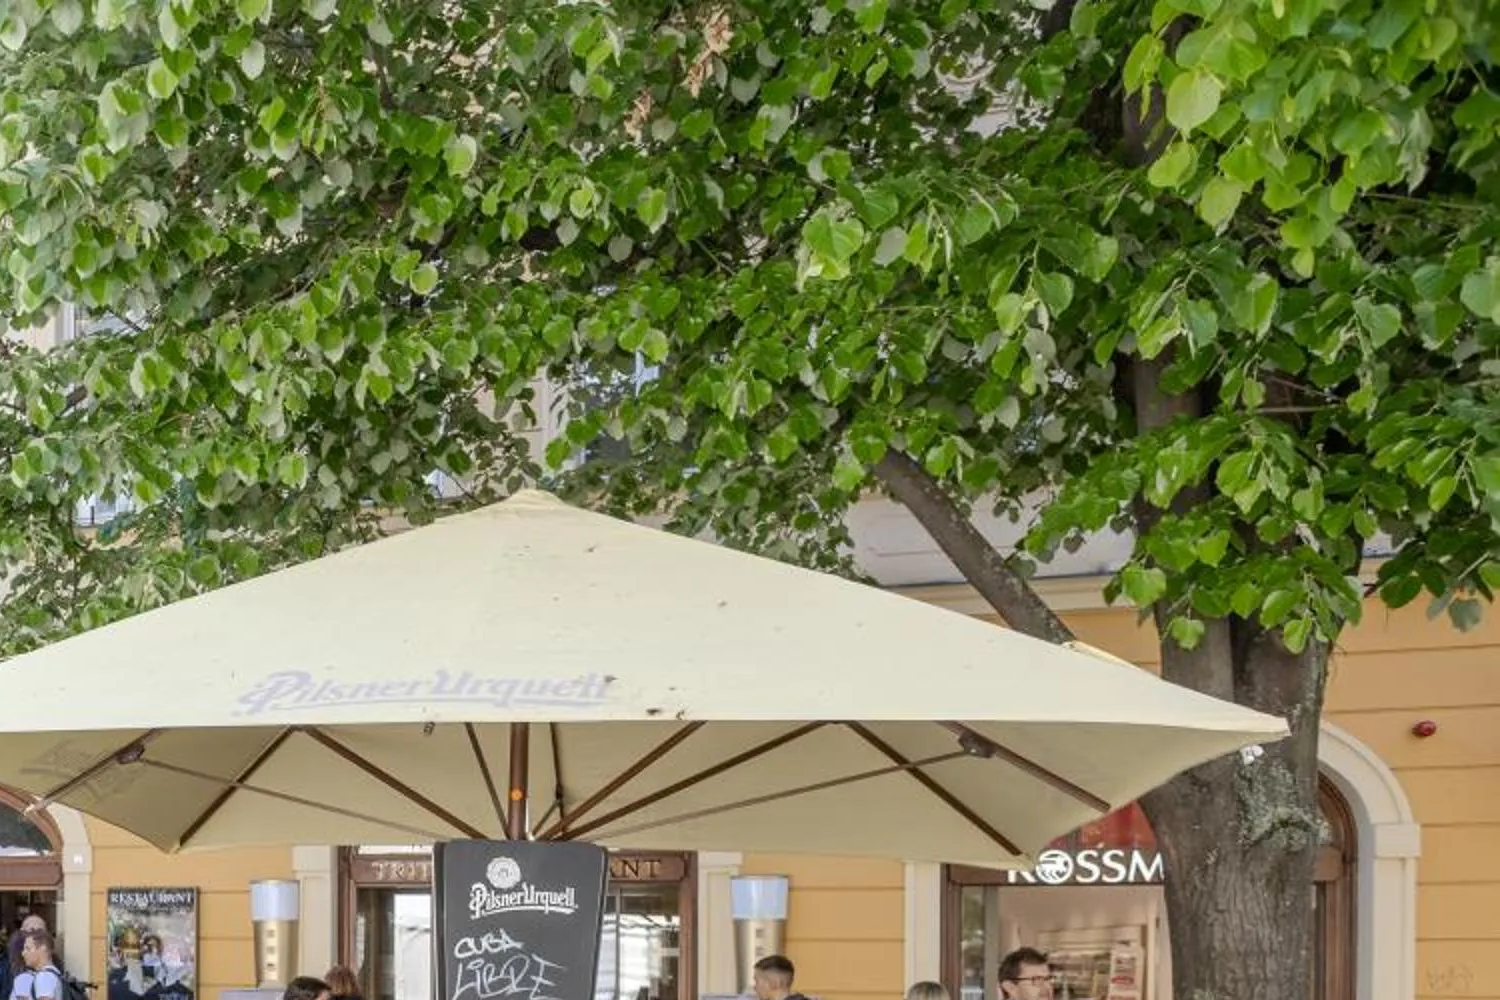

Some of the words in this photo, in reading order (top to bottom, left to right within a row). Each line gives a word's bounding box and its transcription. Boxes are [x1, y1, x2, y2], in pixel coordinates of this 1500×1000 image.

[234, 671, 430, 716] Pilsner
[1007, 849, 1166, 884] OSSM
[470, 882, 523, 920] Pilsner
[521, 884, 576, 914] Urquell
[454, 928, 524, 959] CUBA
